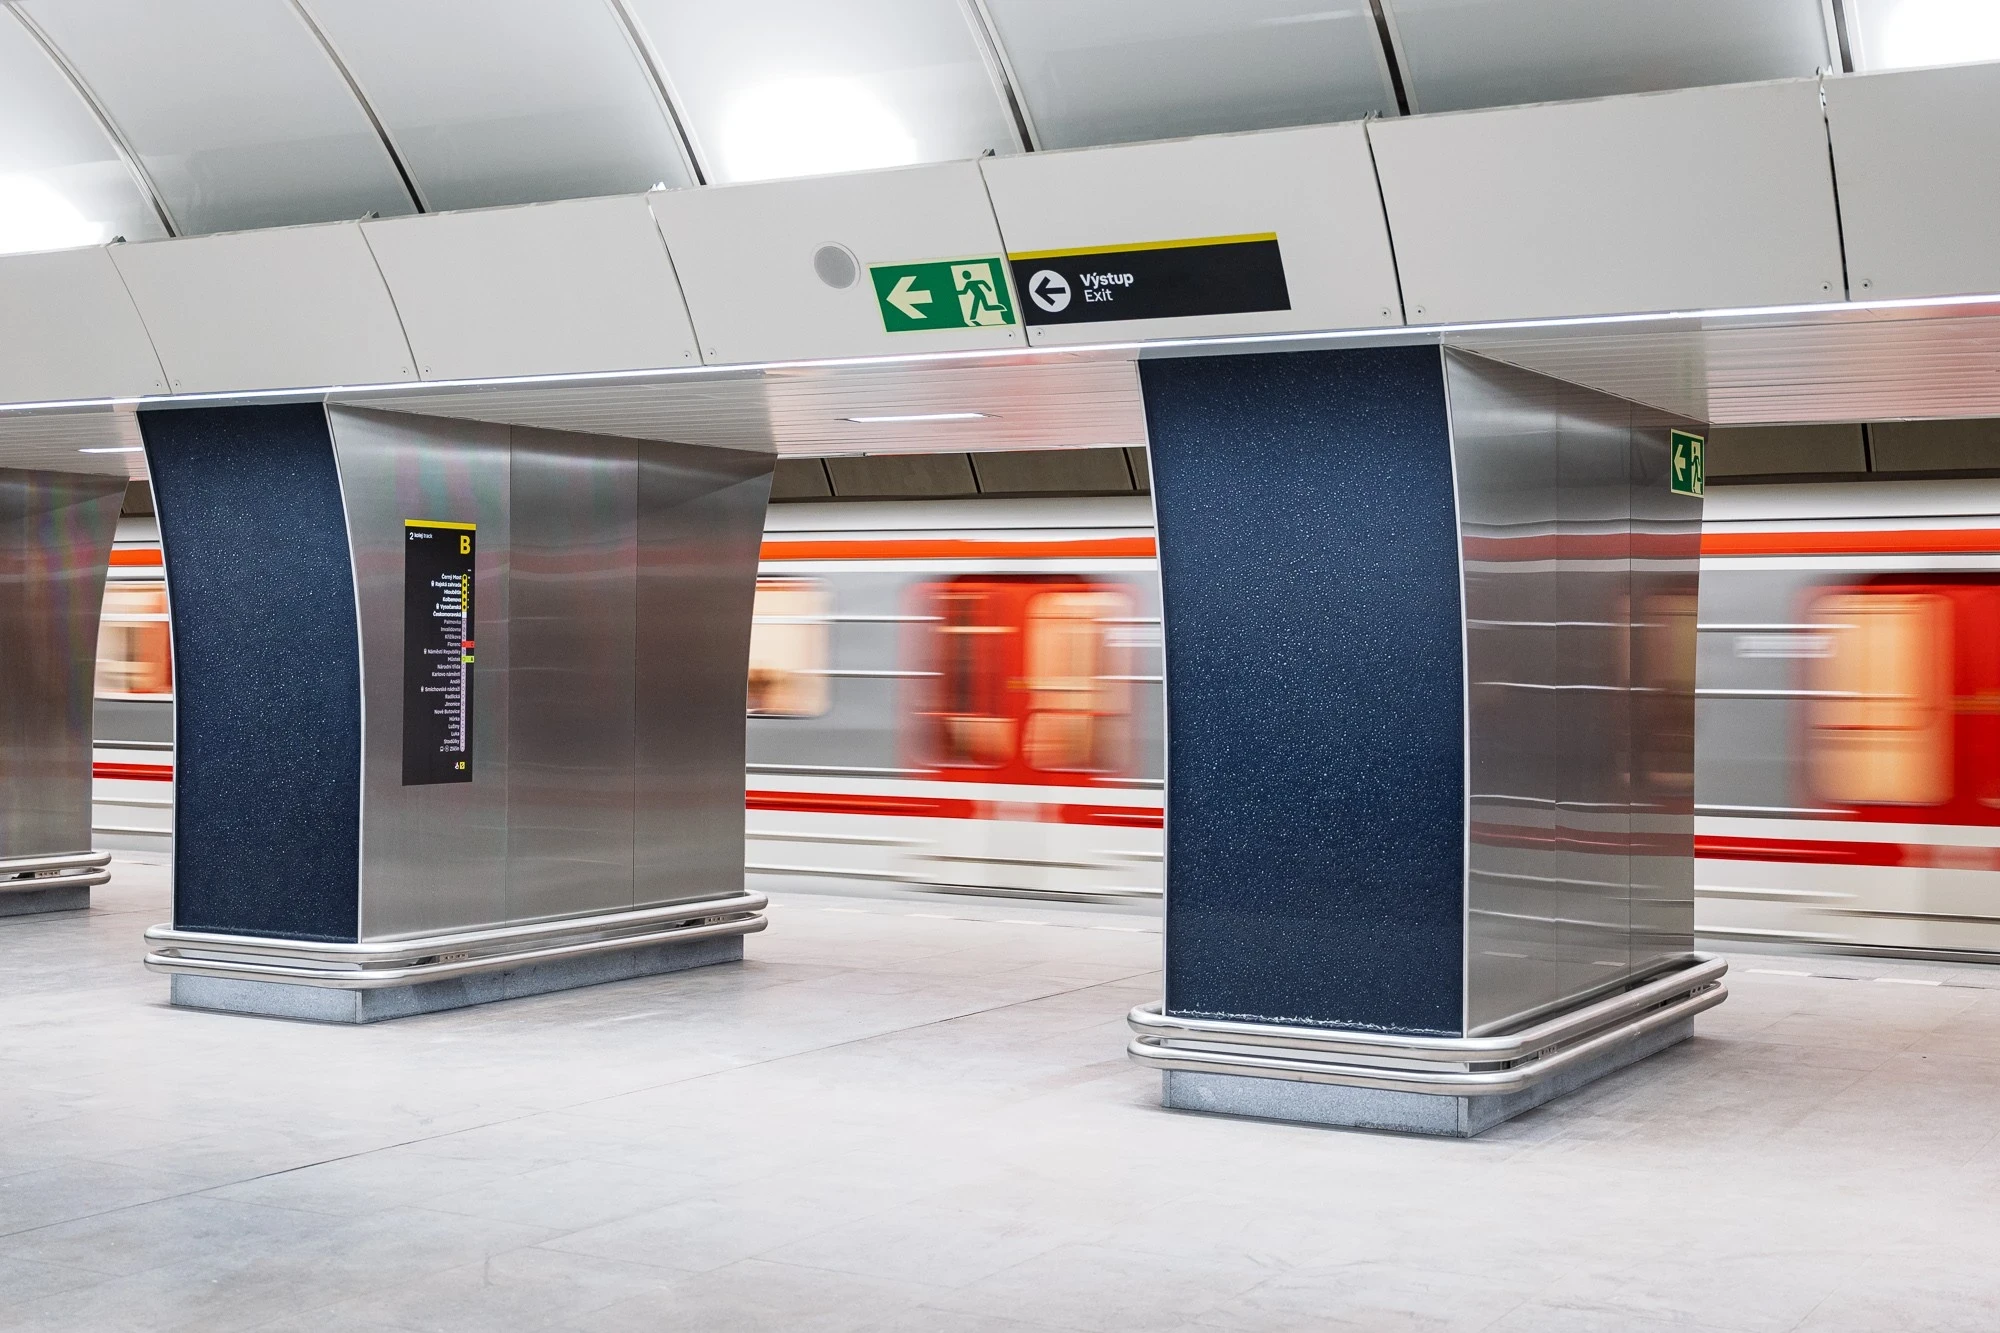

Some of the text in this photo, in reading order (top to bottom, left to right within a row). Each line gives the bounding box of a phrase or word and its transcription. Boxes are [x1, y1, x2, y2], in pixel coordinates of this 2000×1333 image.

[1080, 272, 1134, 289] Výstup
[1084, 288, 1114, 302] Exit
[409, 532, 414, 540] 2
[460, 535, 471, 554] B
